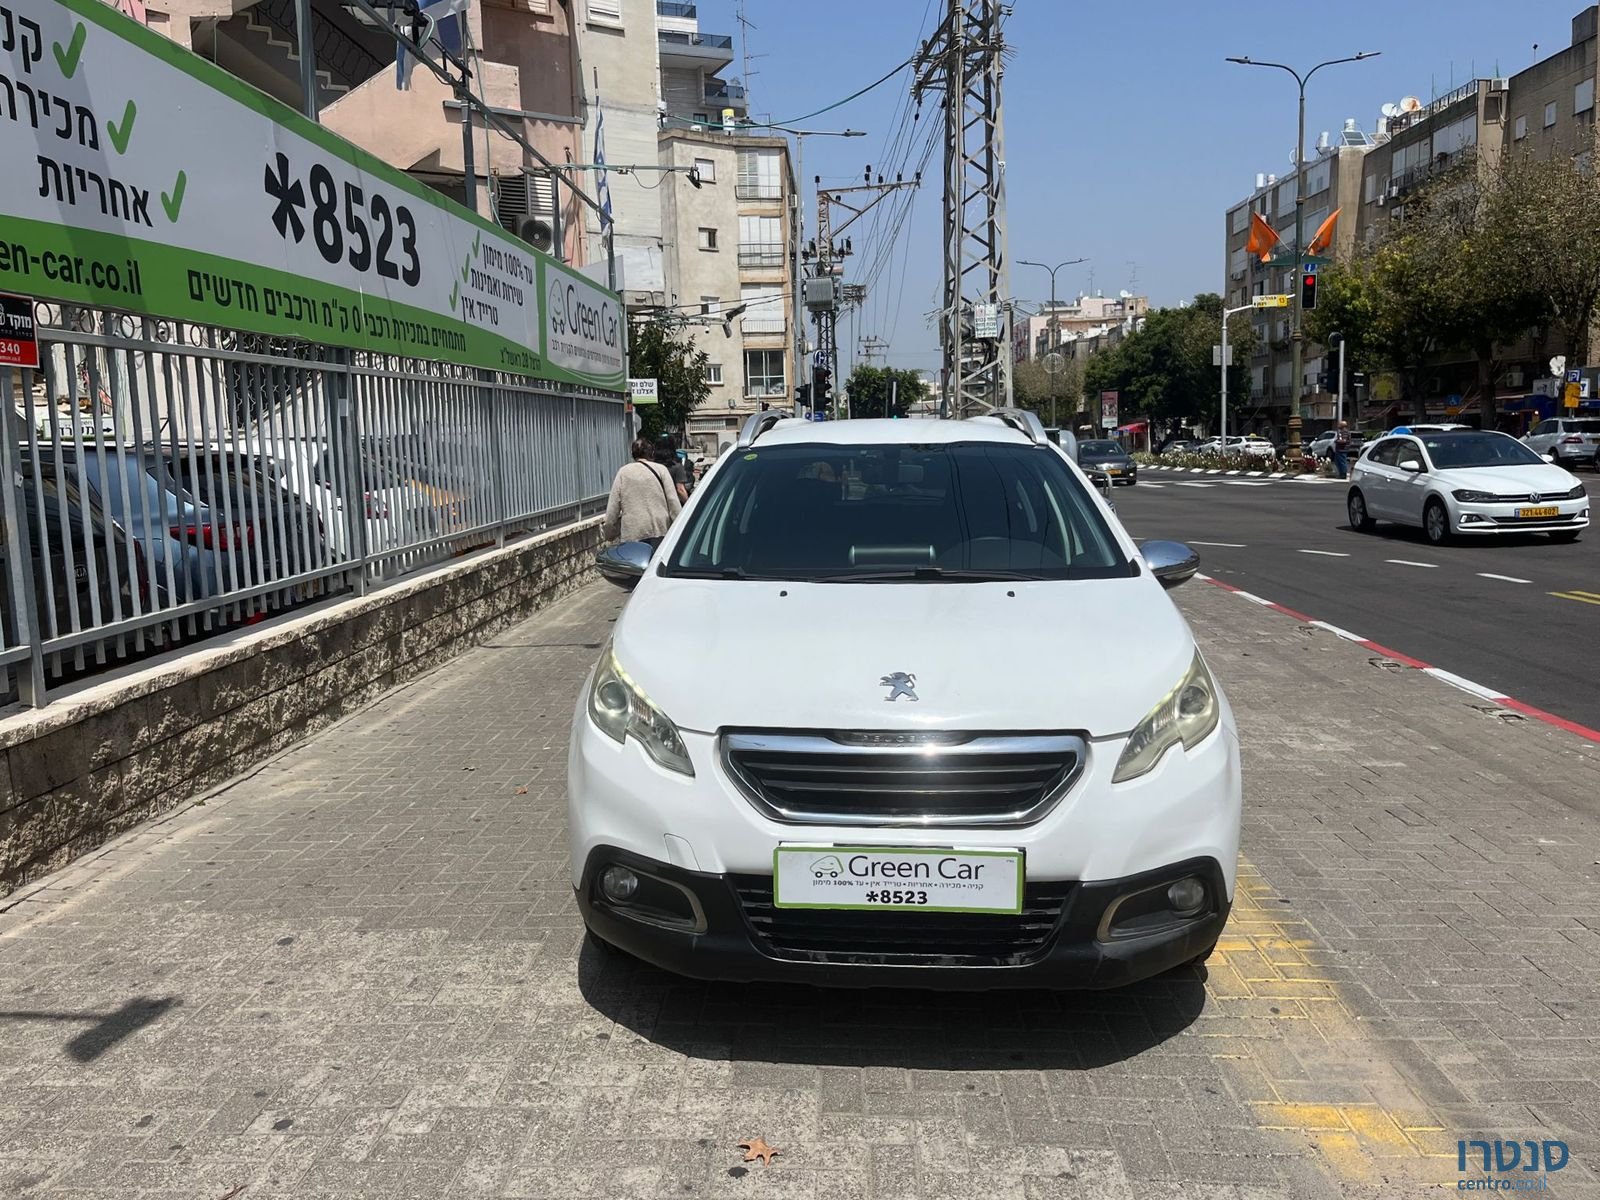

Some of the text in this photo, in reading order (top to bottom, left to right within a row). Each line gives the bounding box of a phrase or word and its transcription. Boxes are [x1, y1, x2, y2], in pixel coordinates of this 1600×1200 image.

[37, 154, 154, 228] אחריות
[482, 243, 533, 285] עד 100% מימון
[187, 269, 260, 312] חדשים
[471, 267, 524, 307] שירות ואמינות
[263, 287, 319, 324] ורכבים
[352, 305, 361, 333] 0
[461, 295, 499, 326] טרייד אין
[566, 284, 618, 348] Green Car
[6, 313, 33, 330] מוקד
[364, 312, 391, 340] רכבי
[392, 317, 431, 345] במכירת
[431, 328, 467, 352] מתמחים
[848, 855, 985, 880] Green Car
[812, 879, 832, 887] מימון
[967, 883, 984, 891] קניה
